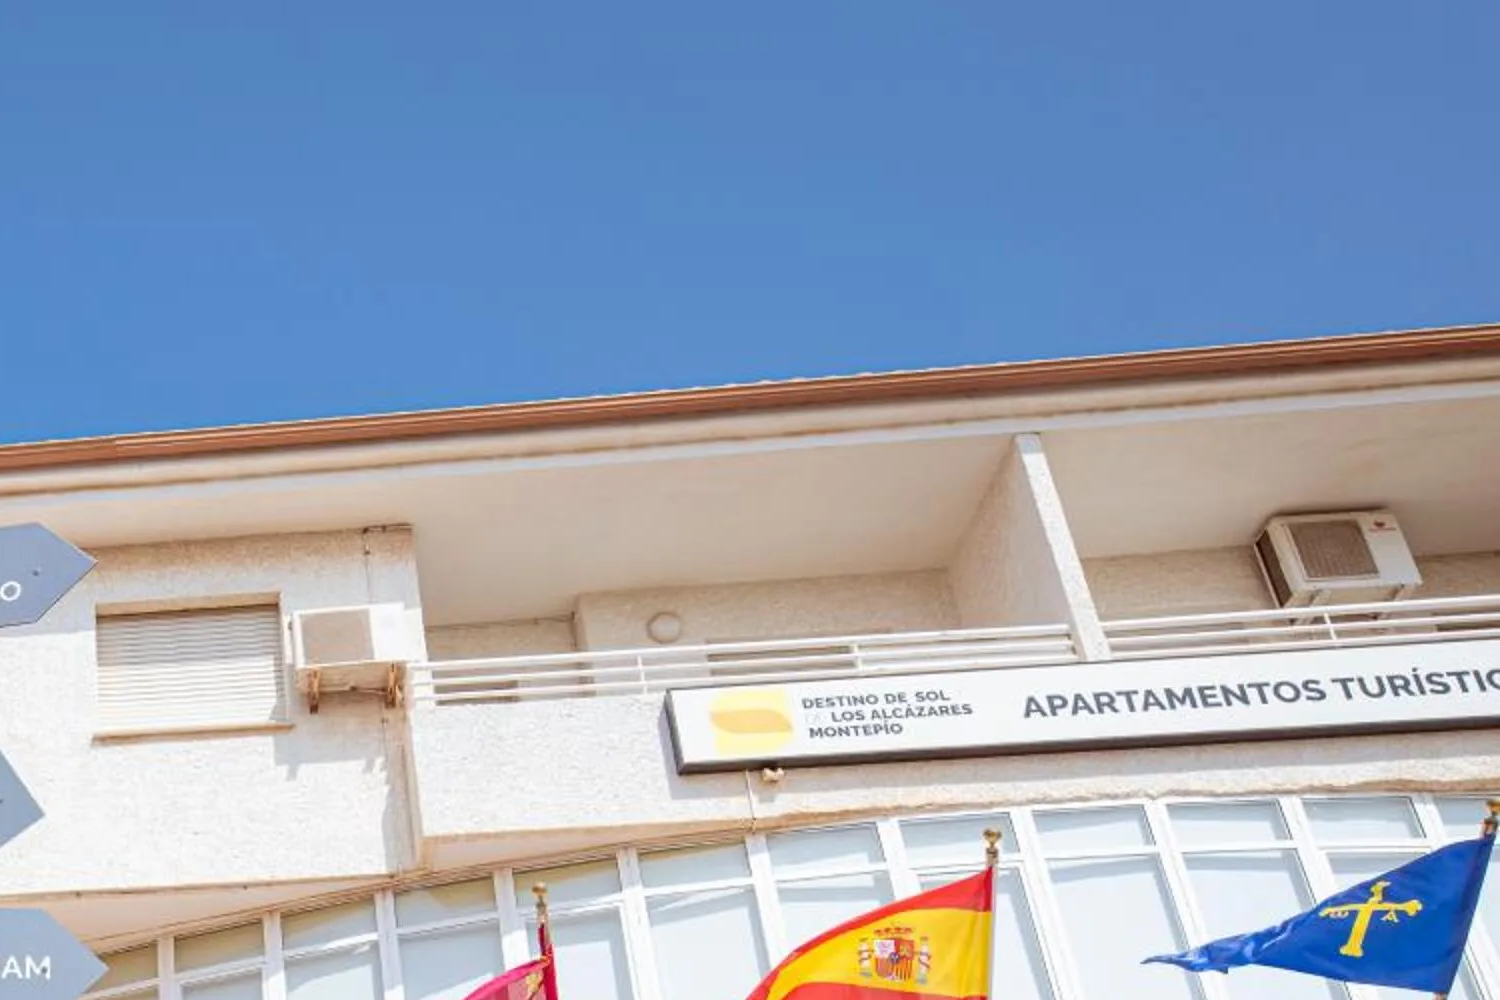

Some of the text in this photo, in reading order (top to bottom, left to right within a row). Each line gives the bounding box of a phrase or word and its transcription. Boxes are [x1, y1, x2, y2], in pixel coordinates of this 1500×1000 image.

[801, 689, 951, 709] DESTINO DE SOL
[1023, 677, 1327, 720] APARTAMENTOS
[831, 709, 866, 723] LOS
[870, 703, 973, 721] ALCÁZARES
[808, 719, 904, 739] MONTEPÍO
